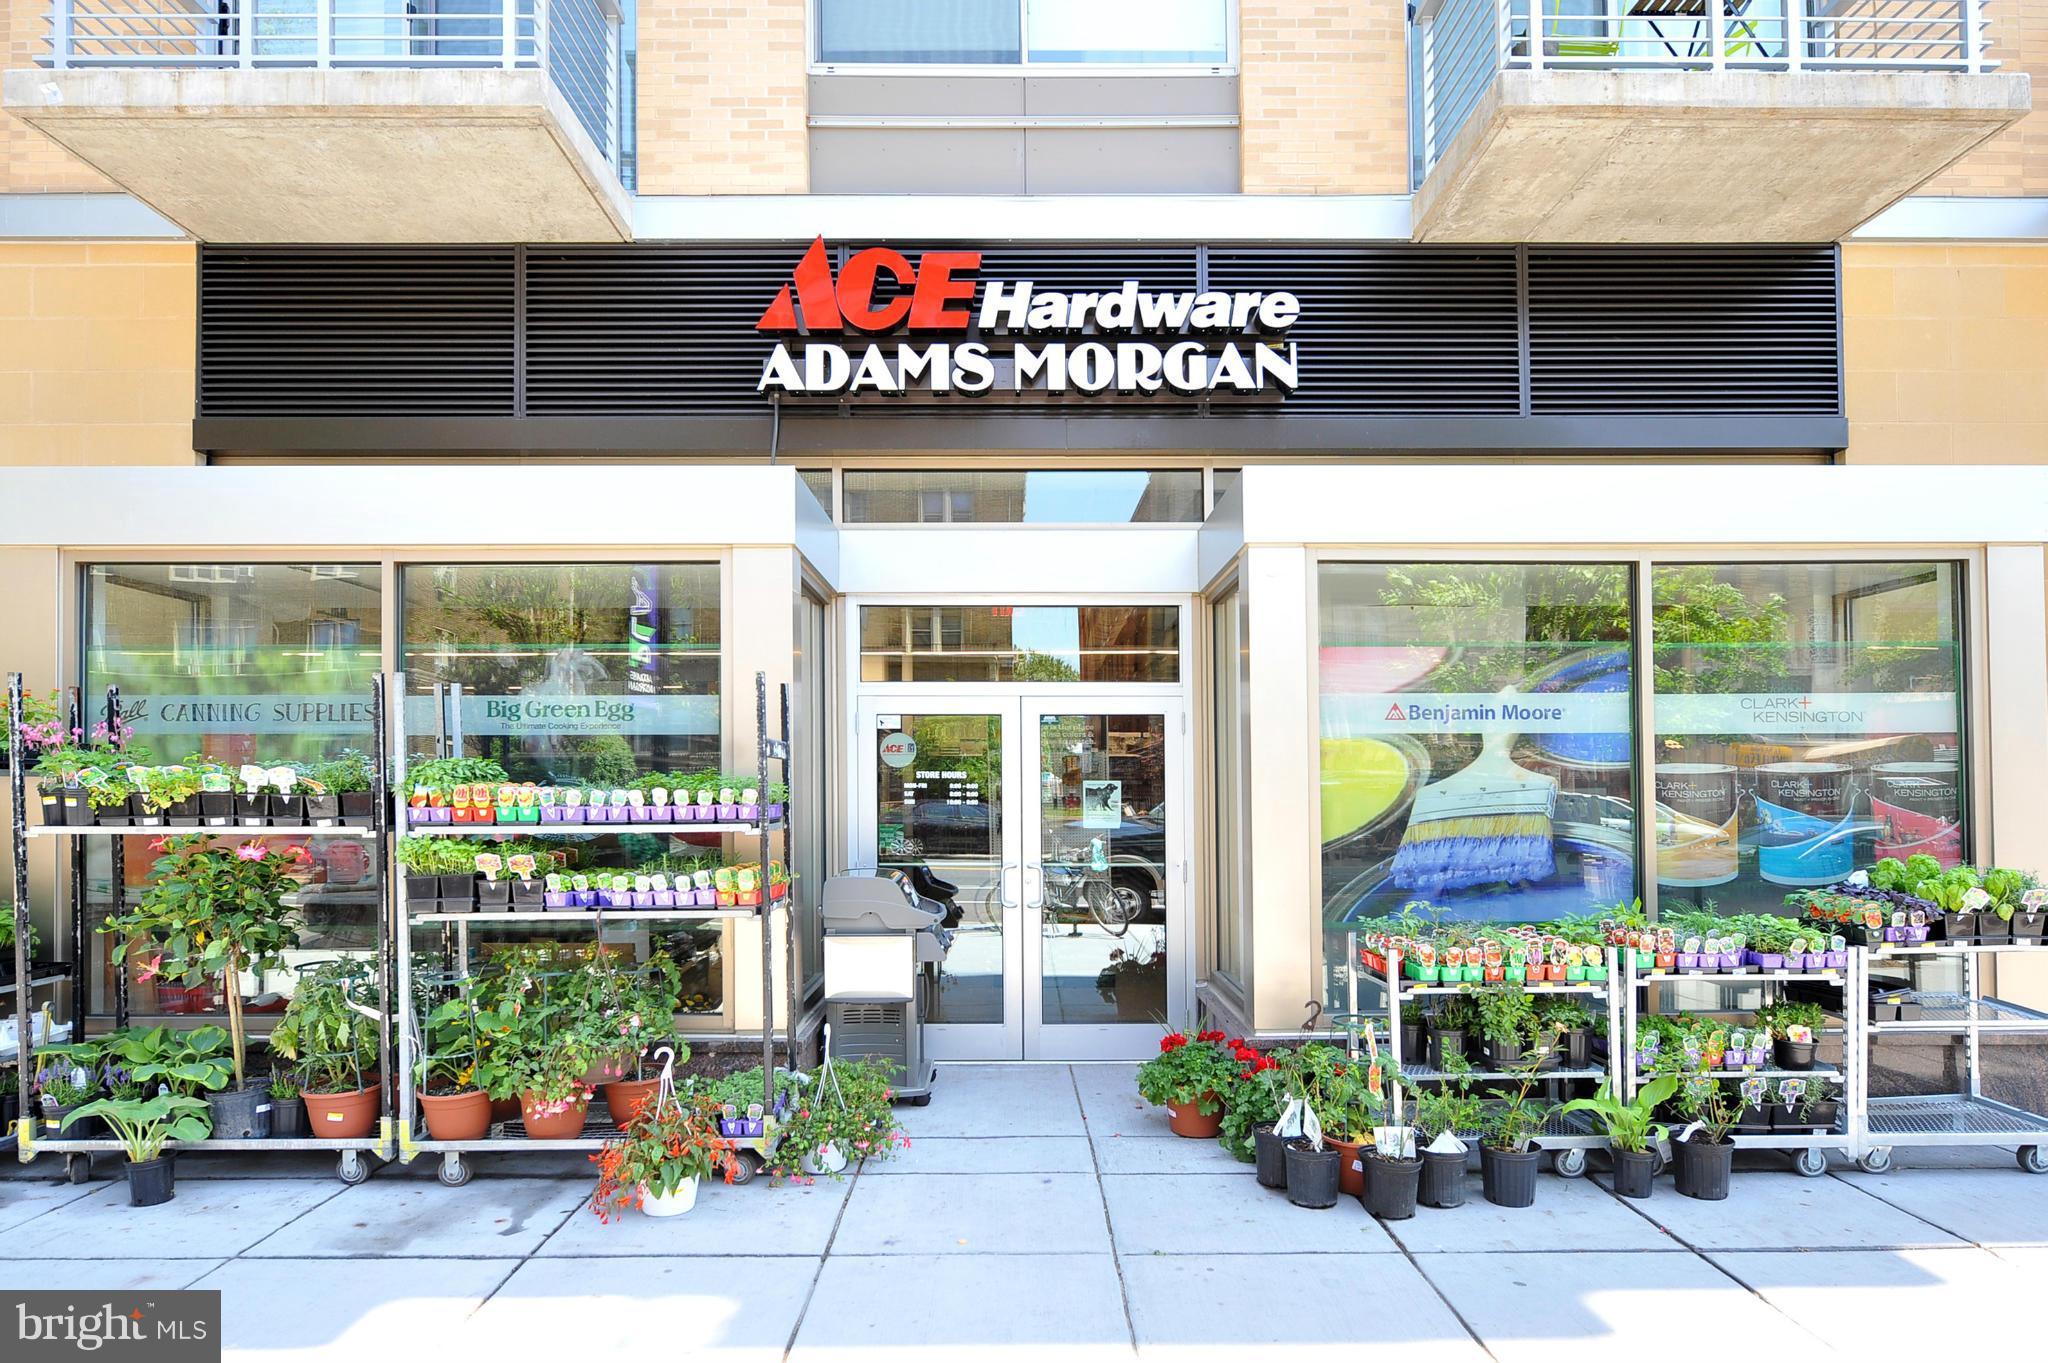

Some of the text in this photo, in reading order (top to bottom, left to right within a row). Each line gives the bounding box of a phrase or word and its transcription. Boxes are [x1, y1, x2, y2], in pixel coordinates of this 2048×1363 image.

[755, 233, 1300, 332] ACE Hardware
[757, 341, 1298, 392] ADAMS MORGAN
[160, 703, 261, 722] CANNING
[272, 702, 375, 722] SUPPLIES
[486, 700, 635, 722] Big Green Egg
[1409, 704, 1562, 724] Benjamin Moore
[1753, 711, 1863, 722] KENSINGTON
[501, 722, 621, 731] The Ultimate Cooking Experience
[882, 744, 904, 753] ACE
[916, 771, 967, 779] STORE HOURS
[1661, 789, 1726, 799] KENSINGTON
[1778, 788, 1841, 798] KENSINGTON
[1894, 788, 1957, 797] KENSINGTON
